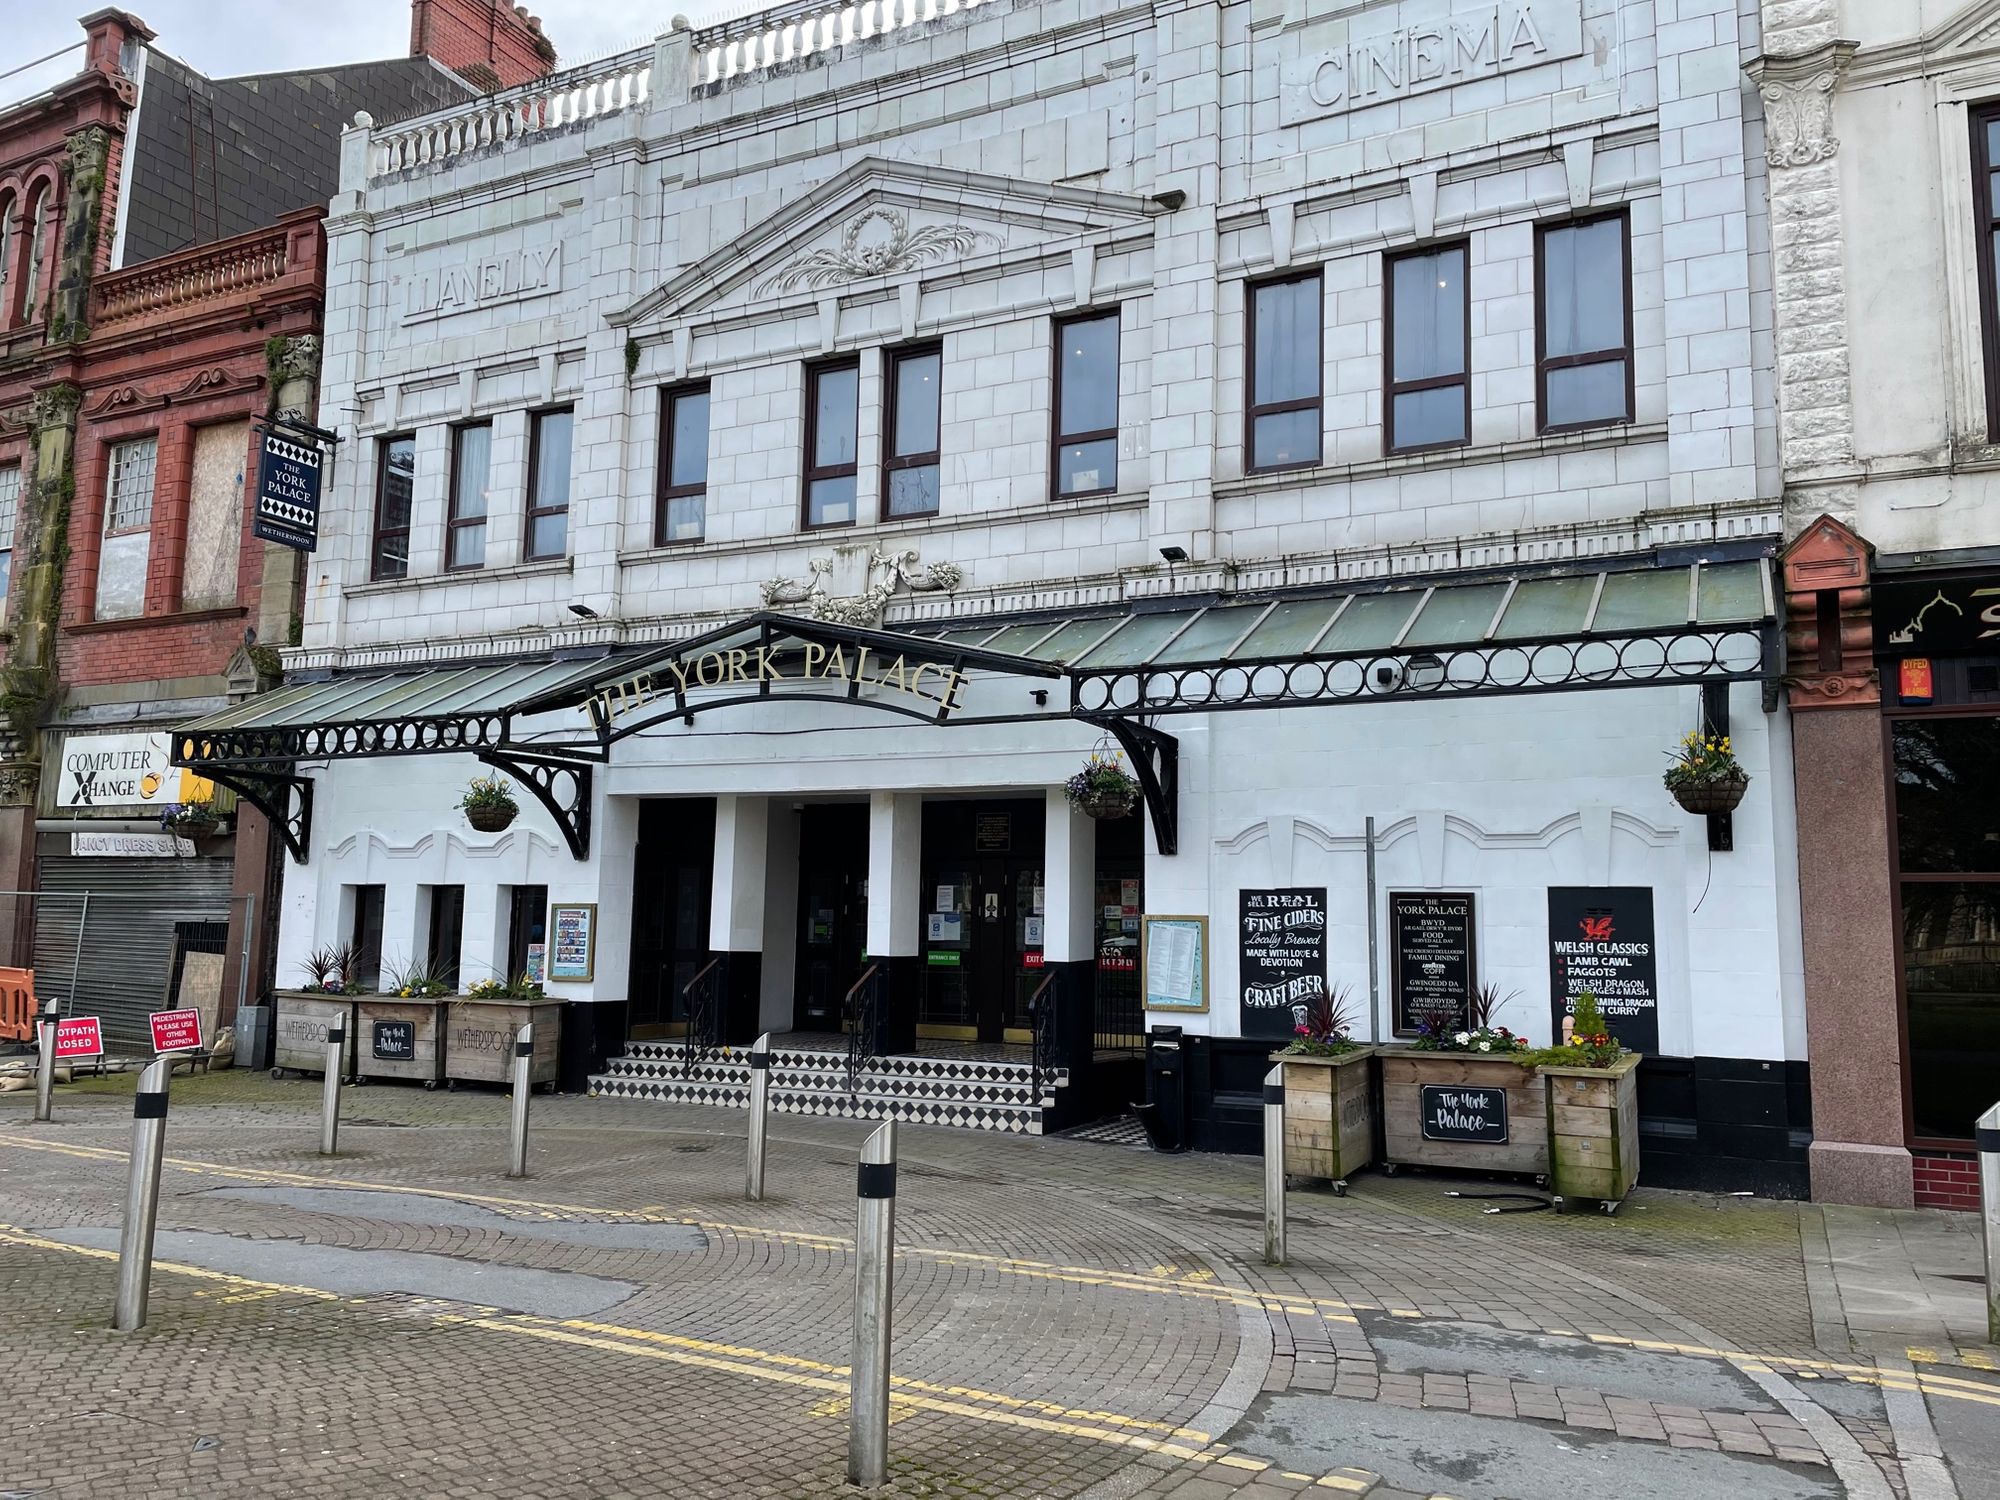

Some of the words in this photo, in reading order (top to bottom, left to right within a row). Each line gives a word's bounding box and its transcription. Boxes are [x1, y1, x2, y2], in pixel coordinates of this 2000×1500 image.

[1308, 6, 1547, 106] CINEMA
[283, 462, 300, 474] THE
[275, 470, 306, 489] YORK
[267, 481, 311, 503] PALACE
[261, 525, 310, 545] WETHERSPOON
[1903, 659, 1928, 669] DYFED
[577, 671, 657, 731] THE
[667, 645, 783, 694] YORK
[803, 643, 972, 711] PALACE
[67, 750, 151, 772] COMPUTER
[115, 838, 155, 851] DRESS
[157, 839, 192, 852] SHOP
[1266, 895, 1318, 908] REAL
[1397, 906, 1426, 914] YORK
[1428, 906, 1468, 915] PALACE
[1244, 915, 1282, 931] FINE
[1284, 909, 1325, 927] CIDERS
[1244, 932, 1281, 948] Locally
[1284, 932, 1322, 945] Brewed
[1246, 949, 1268, 957] MADE
[1269, 949, 1289, 957] WITH
[1312, 950, 1319, 958] &
[1554, 942, 1593, 953] WELSH
[1597, 943, 1649, 955] CLASSICS
[1026, 955, 1039, 963] EXIT
[1260, 959, 1303, 967] DEVOTION
[1567, 957, 1599, 966] LAMB
[1601, 958, 1632, 967] CAWL
[1567, 968, 1617, 976] FAGGOTS
[1567, 979, 1602, 987] WELSH
[1605, 980, 1645, 988] DRAGON
[1244, 984, 1287, 1007] CRAFT
[1288, 975, 1324, 1000] BEER
[1568, 987, 1615, 995] SAUSAGES
[1623, 988, 1649, 996] MASH
[1624, 998, 1655, 1007] DRAGON
[152, 1012, 195, 1023] PEDESTRIANS
[1607, 1007, 1640, 1016] CURRY
[58, 1025, 96, 1037] OTPATH
[156, 1022, 180, 1031] PLEASE
[166, 1030, 187, 1038] OTHER
[58, 1038, 92, 1049] LOSED
[162, 1037, 194, 1047] FOOTPATH
[380, 1037, 402, 1052] Palace
[457, 1028, 516, 1053] WETHERSPOO
[1438, 1093, 1460, 1108] The
[1460, 1093, 1489, 1109] York
[1436, 1108, 1486, 1131] Palace
